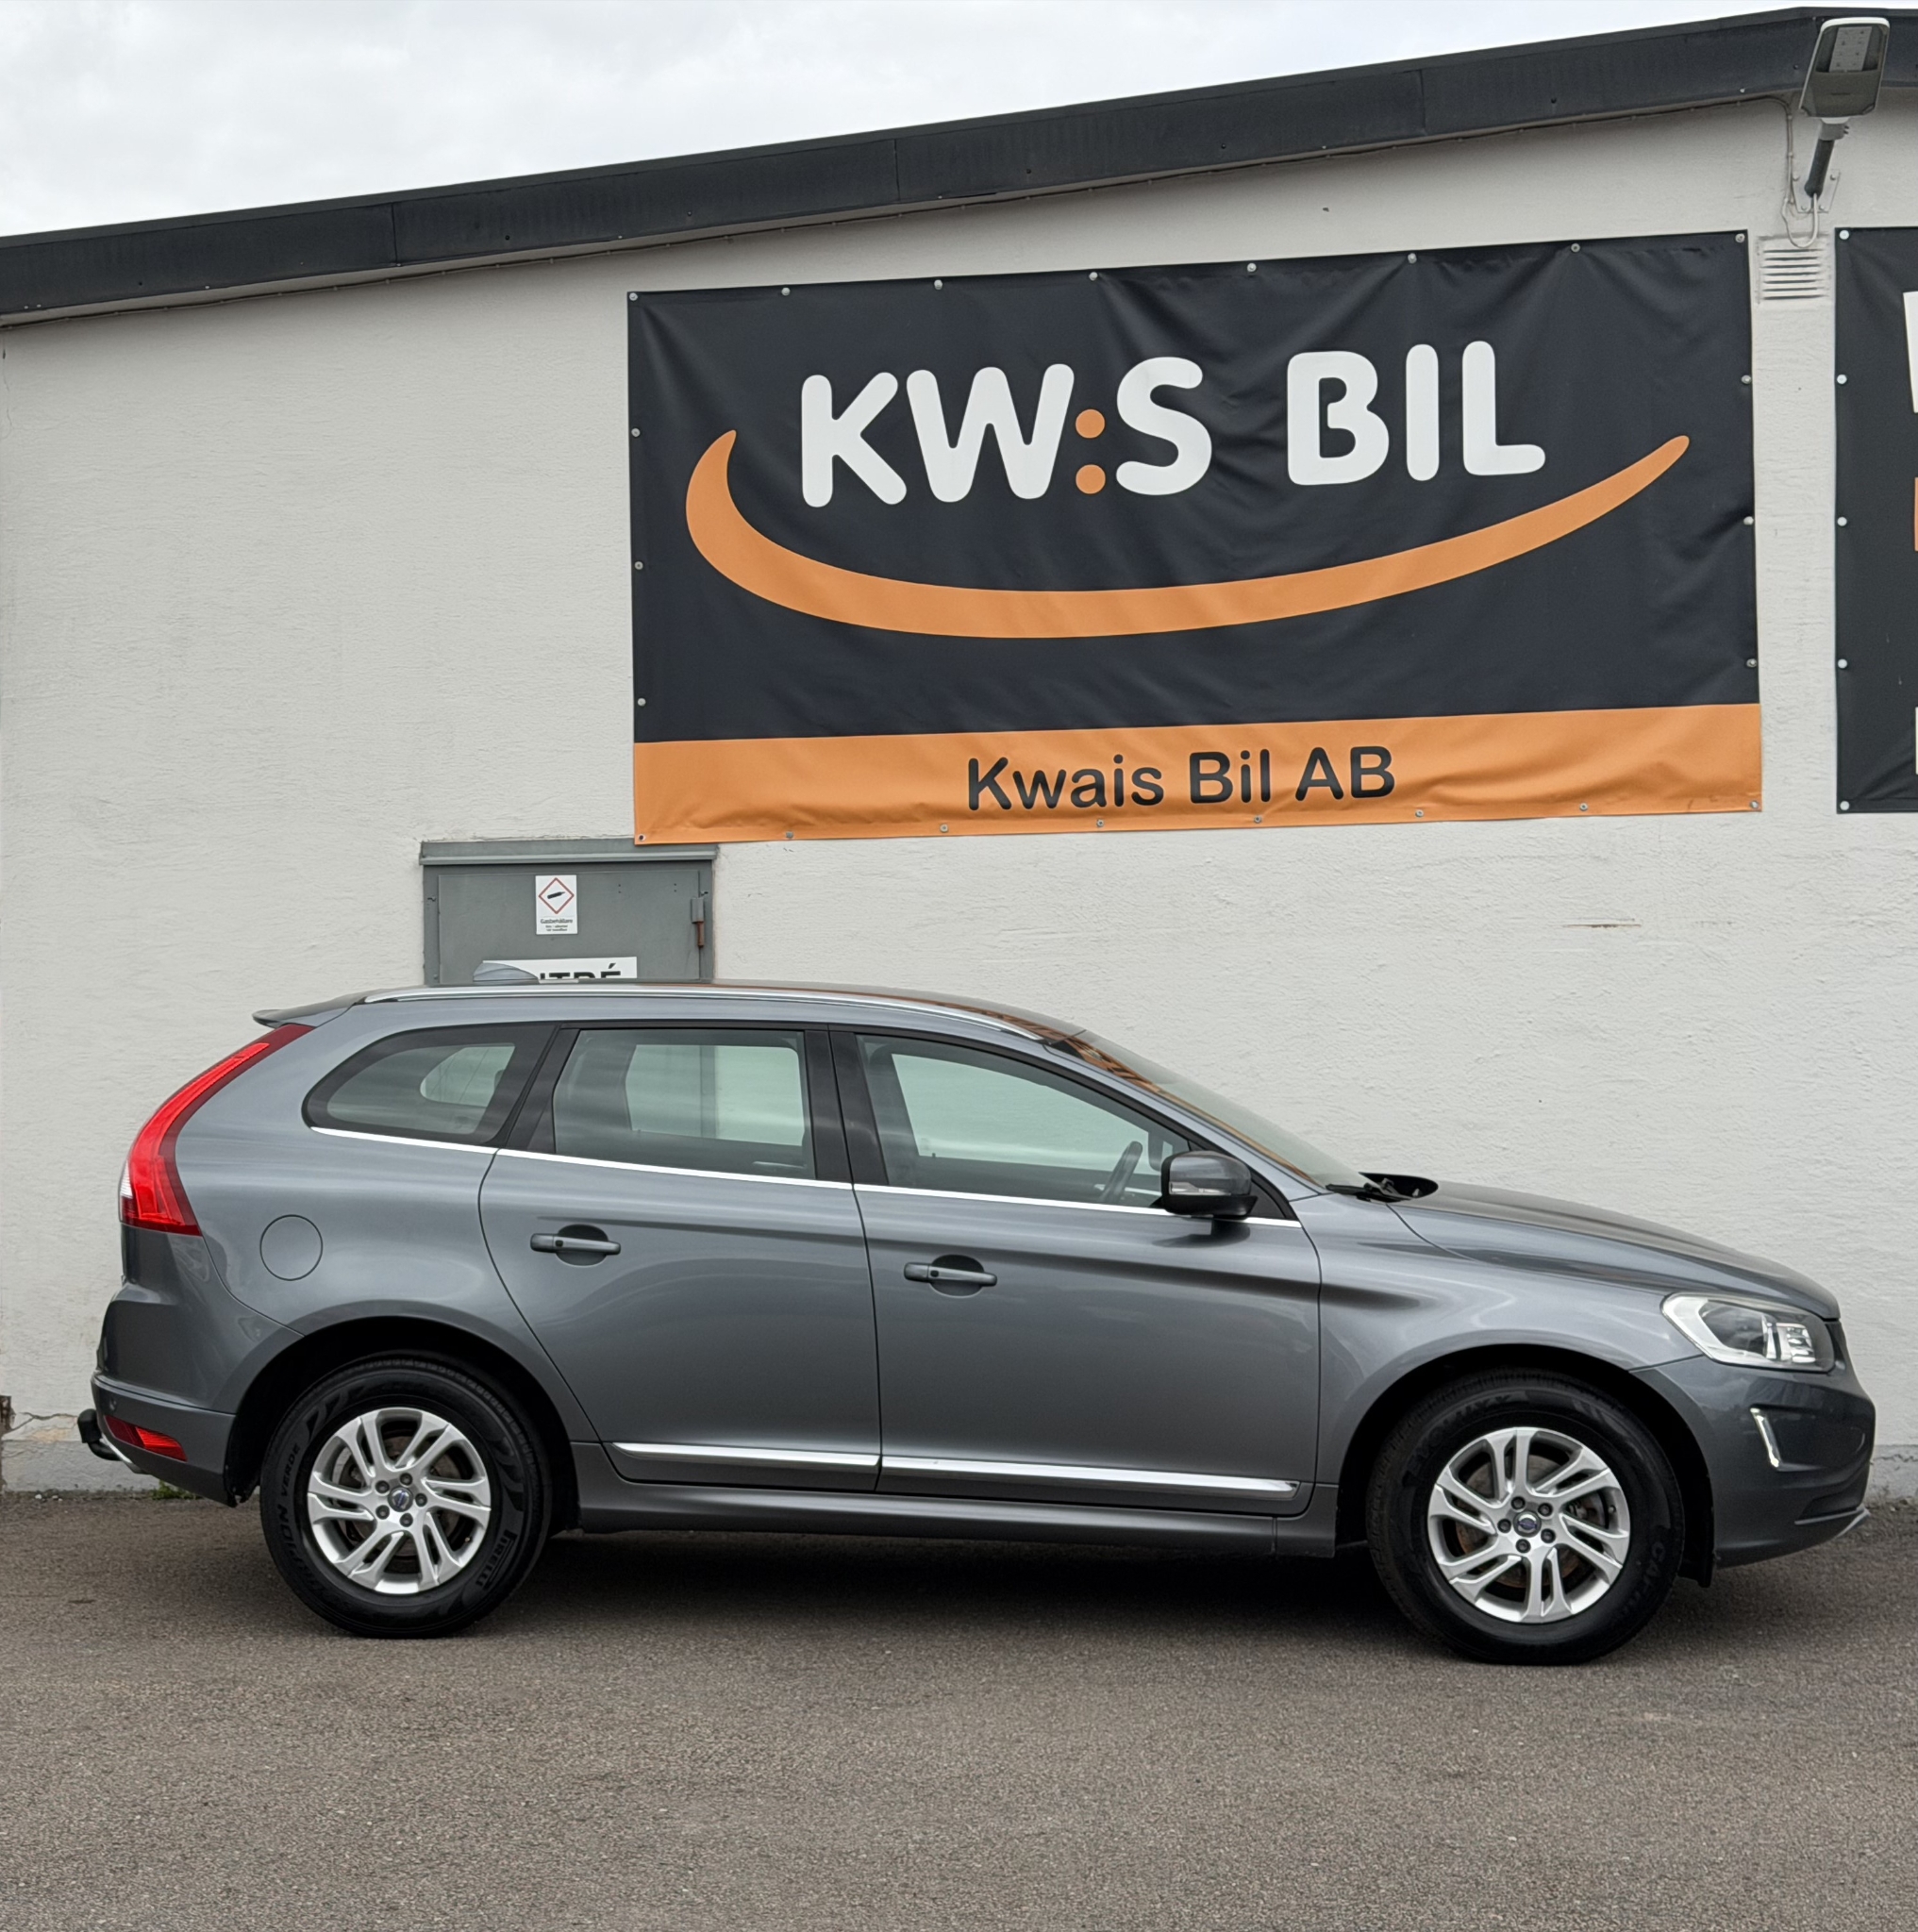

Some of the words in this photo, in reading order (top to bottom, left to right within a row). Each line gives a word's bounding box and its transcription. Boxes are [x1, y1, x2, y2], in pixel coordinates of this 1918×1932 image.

[801, 357, 1212, 508] KW:S
[1287, 341, 1545, 486] BIL
[968, 754, 1164, 811] Kwais
[1189, 749, 1271, 805] Bil
[1294, 745, 1395, 802] AB
[475, 1528, 518, 1591] PIRELLI
